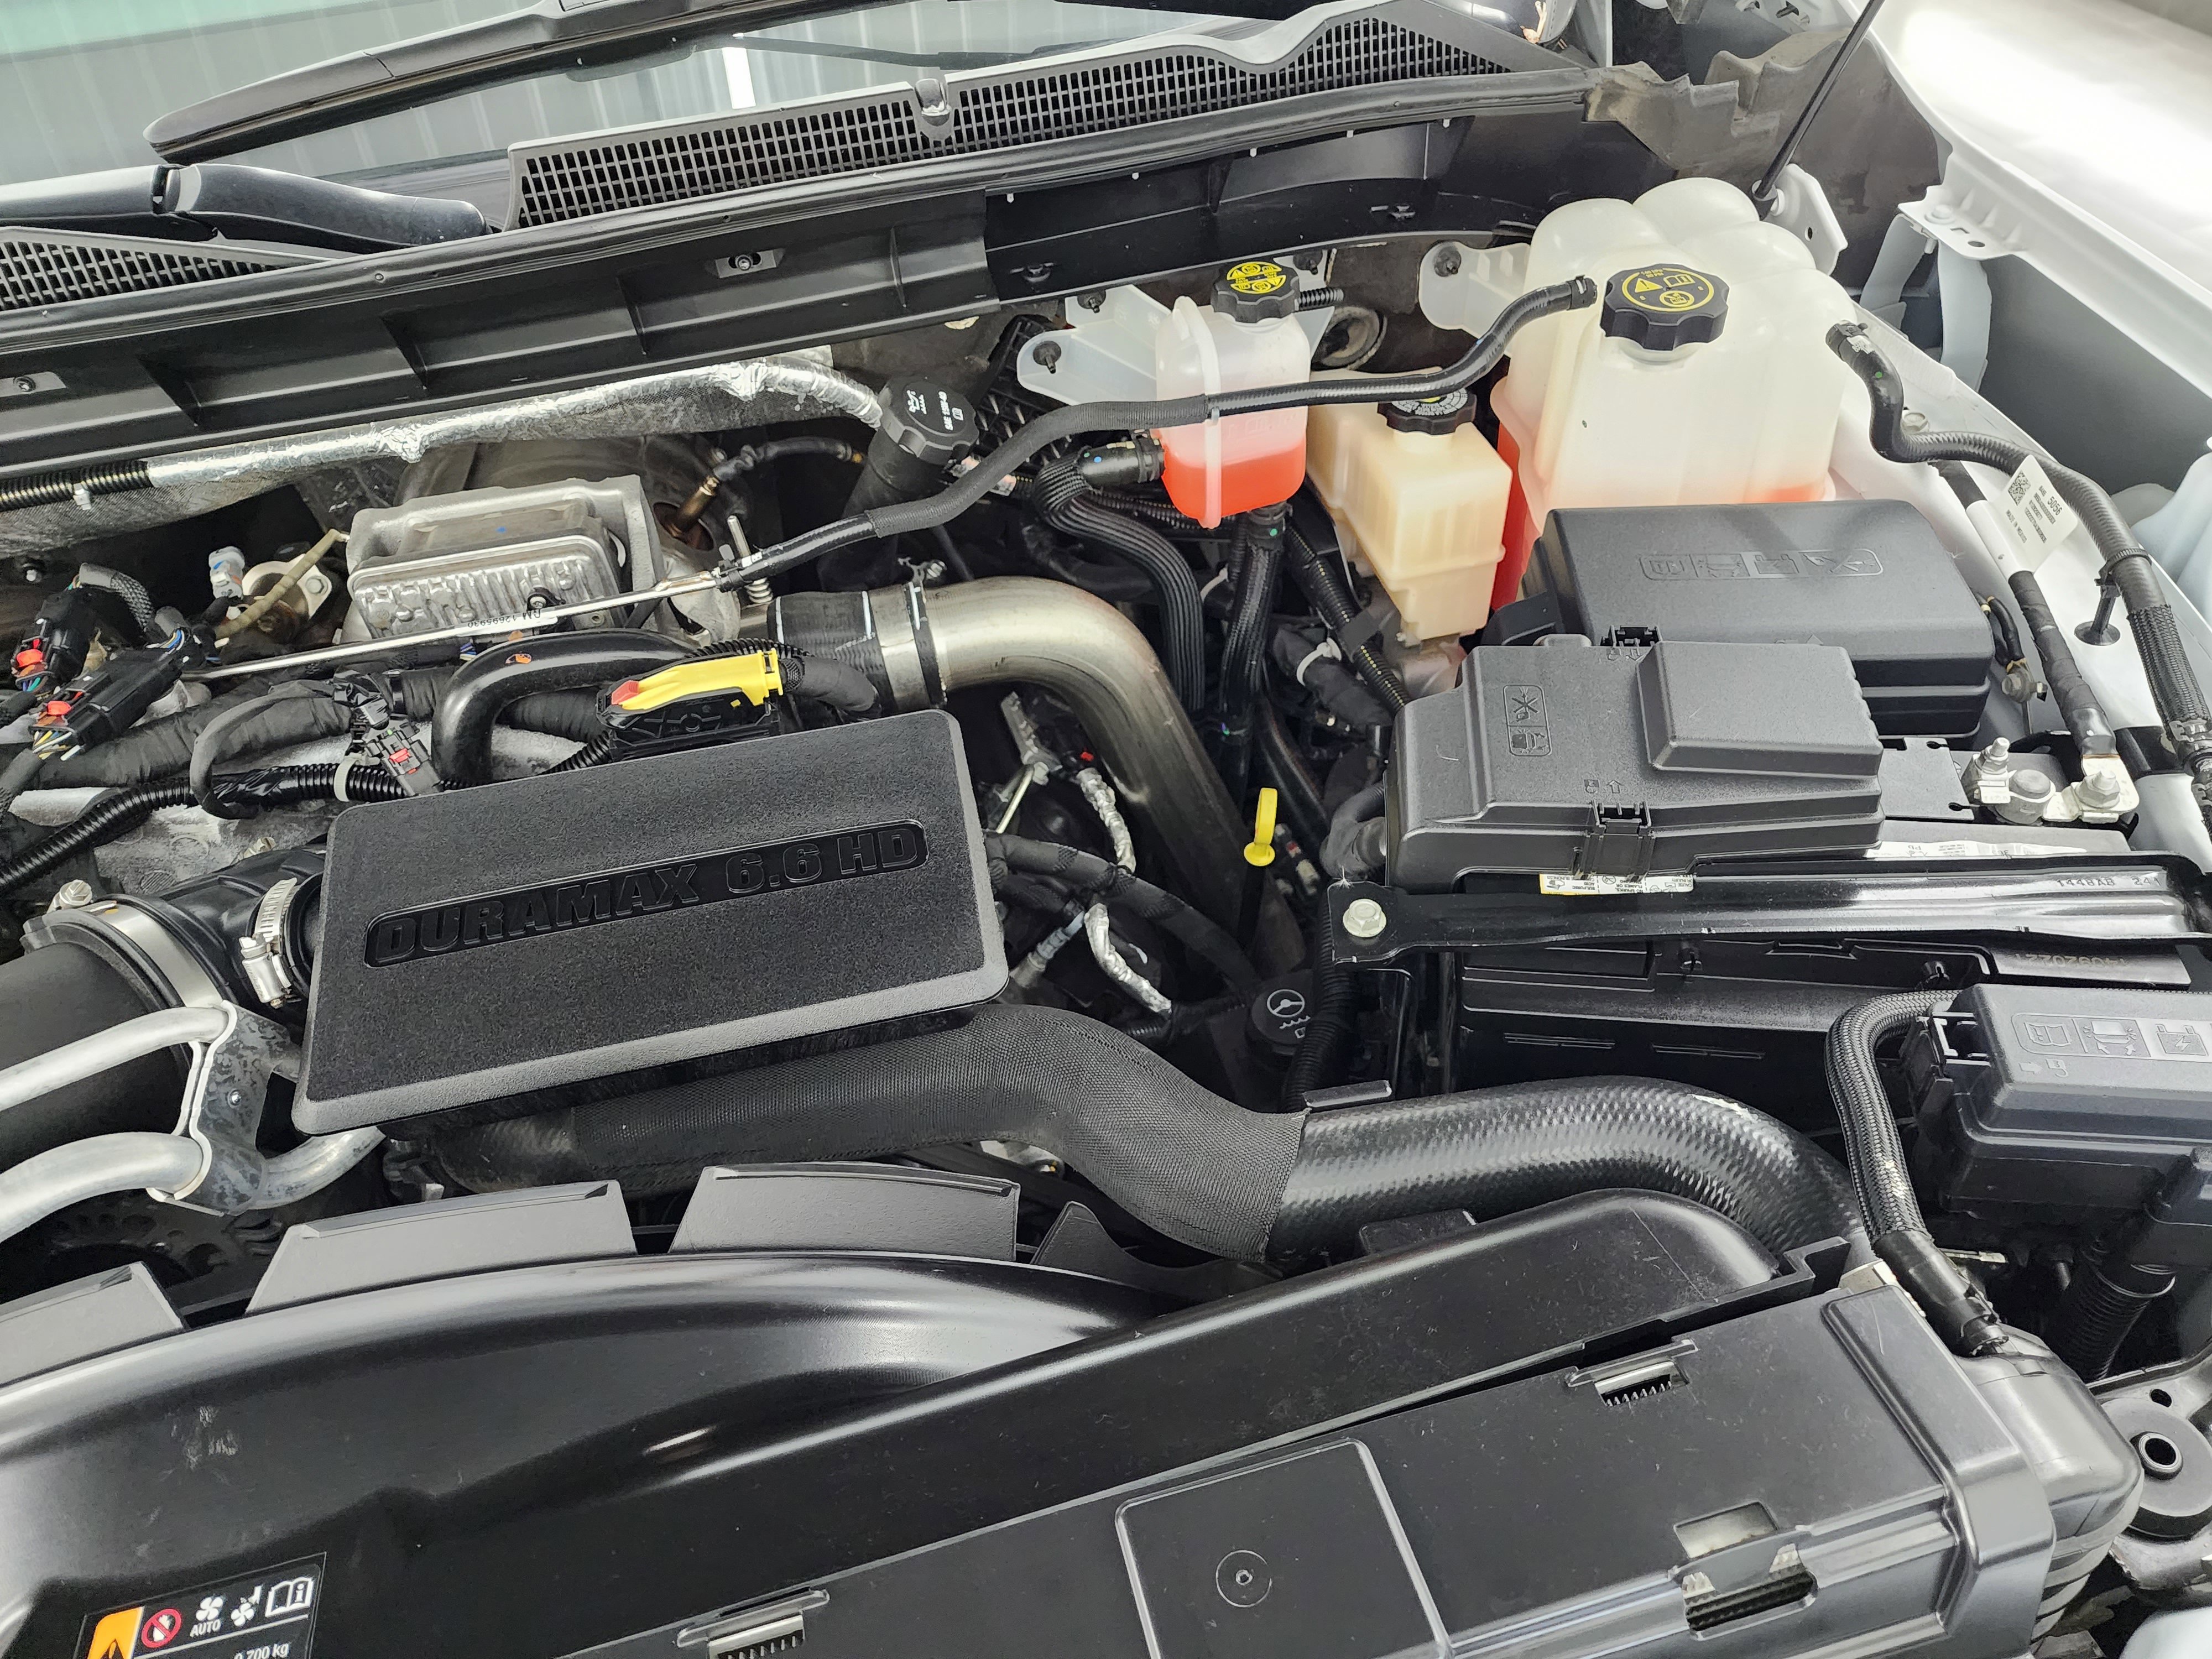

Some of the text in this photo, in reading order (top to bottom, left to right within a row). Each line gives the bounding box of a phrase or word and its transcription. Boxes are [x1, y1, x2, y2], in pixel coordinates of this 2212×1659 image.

[943, 416, 953, 430] SAE
[2047, 496, 2063, 515] 5056
[377, 826, 920, 962] DURAMAX 6.6 HD
[190, 1619, 221, 1637] AUTO
[272, 1642, 290, 1658] kg
